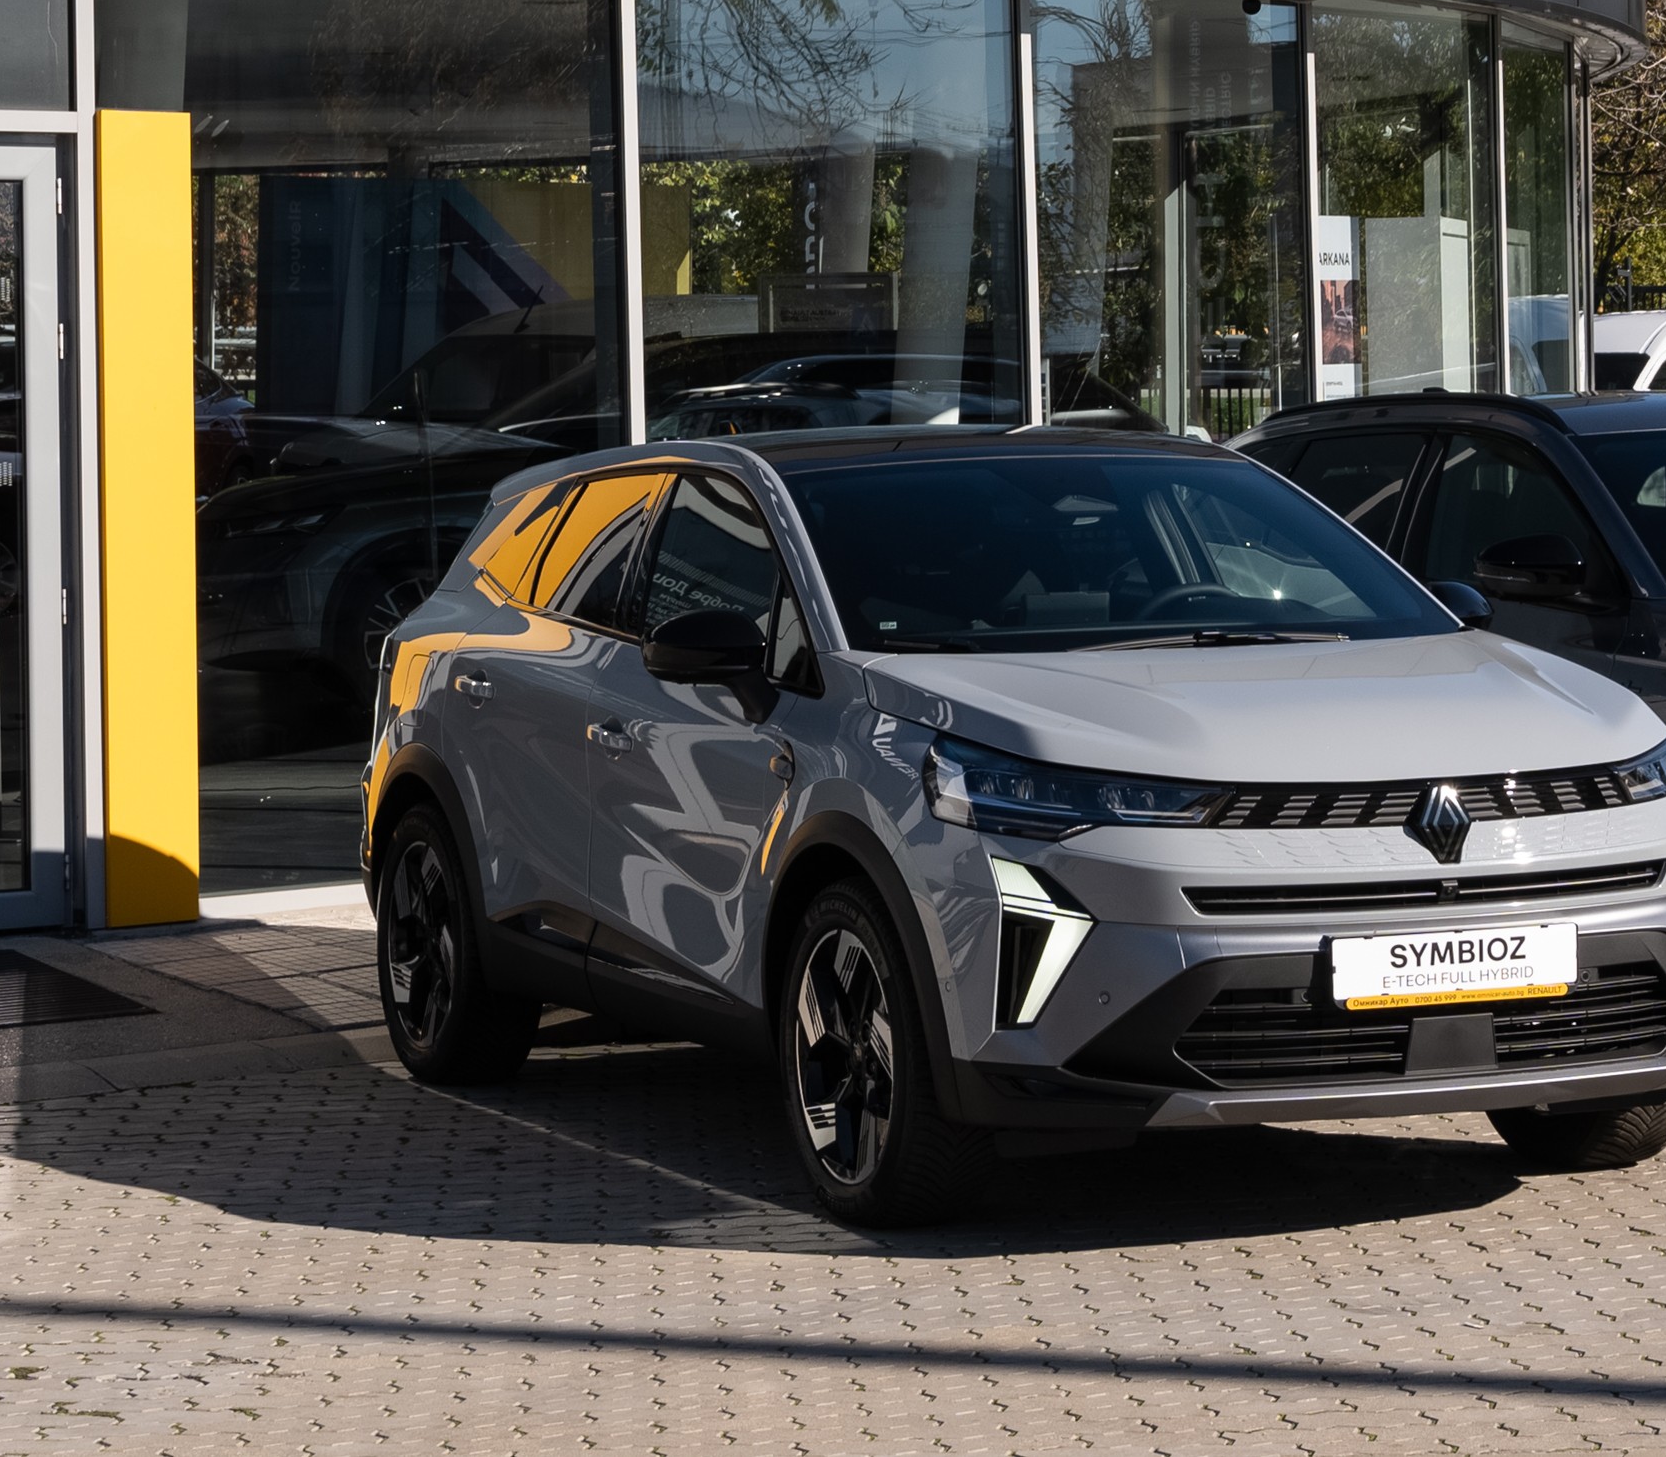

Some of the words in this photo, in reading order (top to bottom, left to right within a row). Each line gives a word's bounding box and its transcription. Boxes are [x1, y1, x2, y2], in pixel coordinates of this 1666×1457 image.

[1390, 936, 1526, 969] SYMBIOZ
[1383, 972, 1436, 988] E-TECH
[1441, 969, 1476, 985] FULL
[1479, 965, 1534, 981] HYBRID
[1353, 997, 1389, 1008] Омникар
[1390, 996, 1409, 1007] Ауто
[1415, 994, 1432, 1003] 0700
[1434, 994, 1442, 1002] 45
[1443, 993, 1457, 1002] 999
[1461, 989, 1524, 1000] www.omnicar-auto.bg
[1527, 985, 1563, 995] RENAULT
